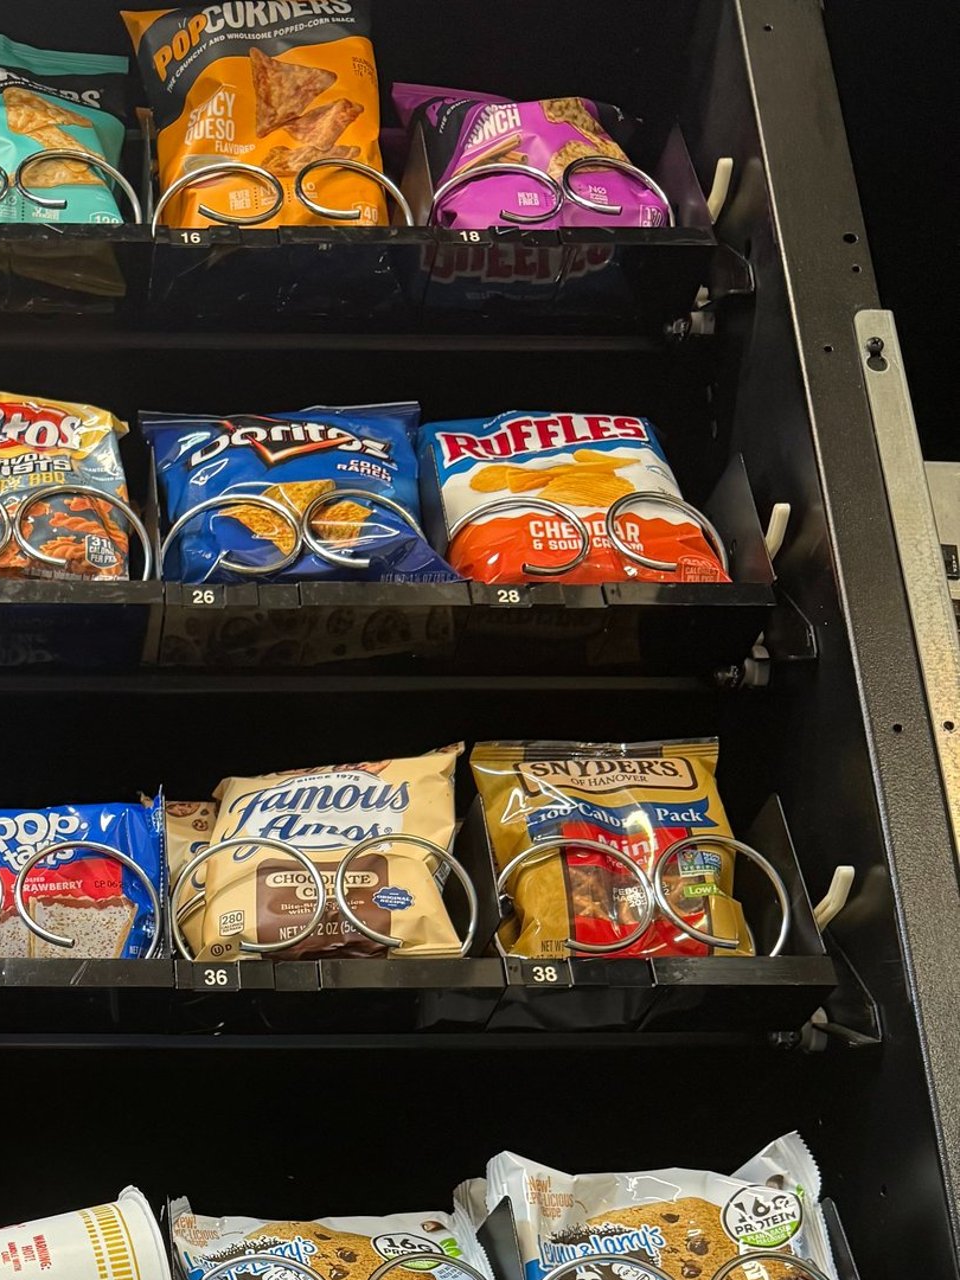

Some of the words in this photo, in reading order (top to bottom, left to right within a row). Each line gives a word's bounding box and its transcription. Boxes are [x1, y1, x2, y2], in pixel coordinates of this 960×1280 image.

[176, 42, 208, 80] CRUNCHY
[208, 35, 226, 46] AND
[227, 31, 272, 40] WHOLESOME
[273, 17, 330, 38] POPPED-CORN
[187, 92, 236, 129] SPICY
[185, 118, 236, 146] QUESO
[180, 232, 202, 244] 16
[459, 231, 480, 242] 18
[191, 423, 390, 467] Doritos
[439, 415, 646, 465] RUFFLES
[28, 472, 67, 486] BBQ
[533, 538, 543, 551] &
[192, 591, 215, 604] 26
[497, 590, 520, 603] 28
[587, 773, 648, 787] HANOVER
[220, 778, 411, 845] Famous
[655, 808, 704, 823] Pack
[597, 833, 660, 857] Mini
[689, 884, 712, 895] Low
[222, 912, 243, 925] 280
[541, 941, 555, 952] NET
[204, 969, 228, 985] 36
[532, 966, 558, 982] 38
[734, 1209, 798, 1237] PROTEIN
[21, 1243, 36, 1264] HOT!
[32, 1234, 52, 1271] WARNING:
